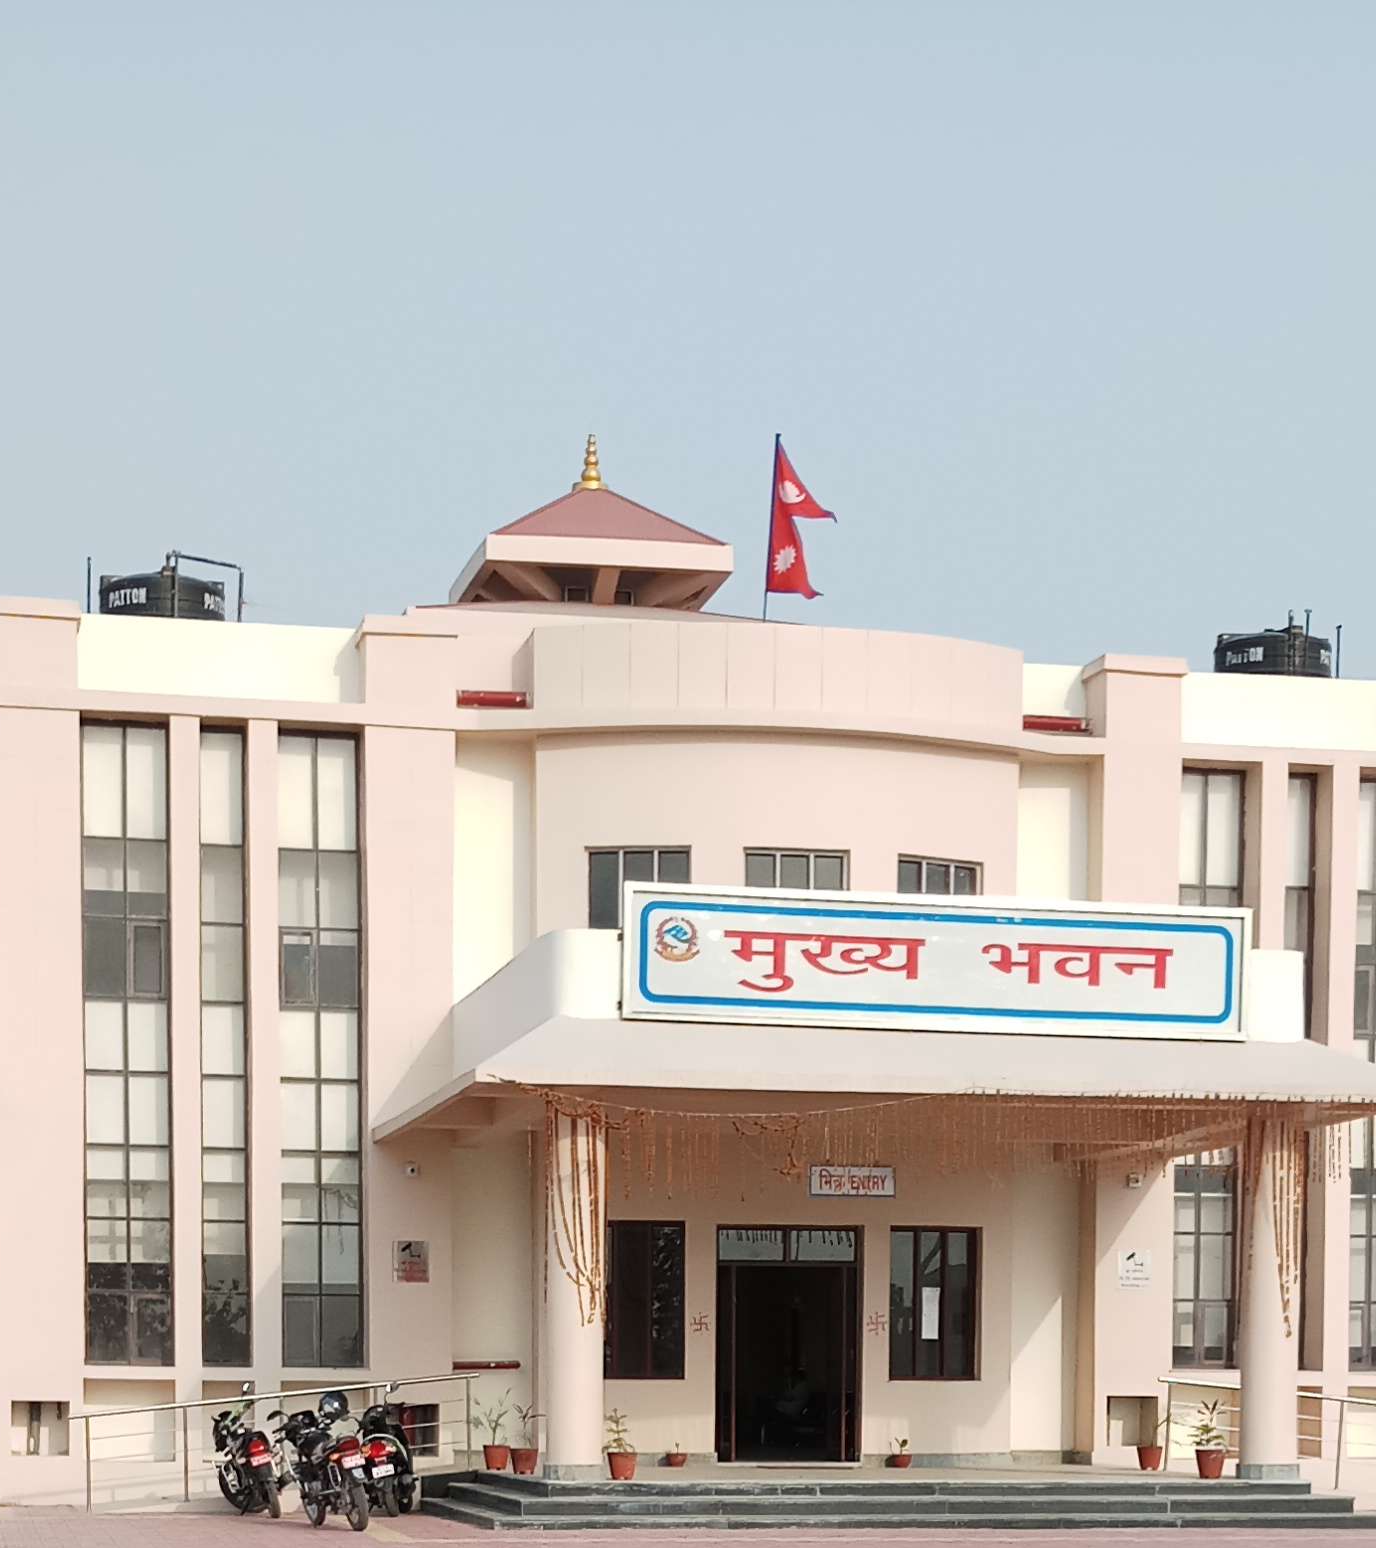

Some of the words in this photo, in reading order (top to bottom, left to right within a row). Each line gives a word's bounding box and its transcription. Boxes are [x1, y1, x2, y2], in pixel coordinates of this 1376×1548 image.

[108, 587, 147, 608] PATTON
[724, 929, 926, 993] मुख्य
[981, 942, 1173, 989] भवन
[851, 1174, 887, 1191] ENTRY
